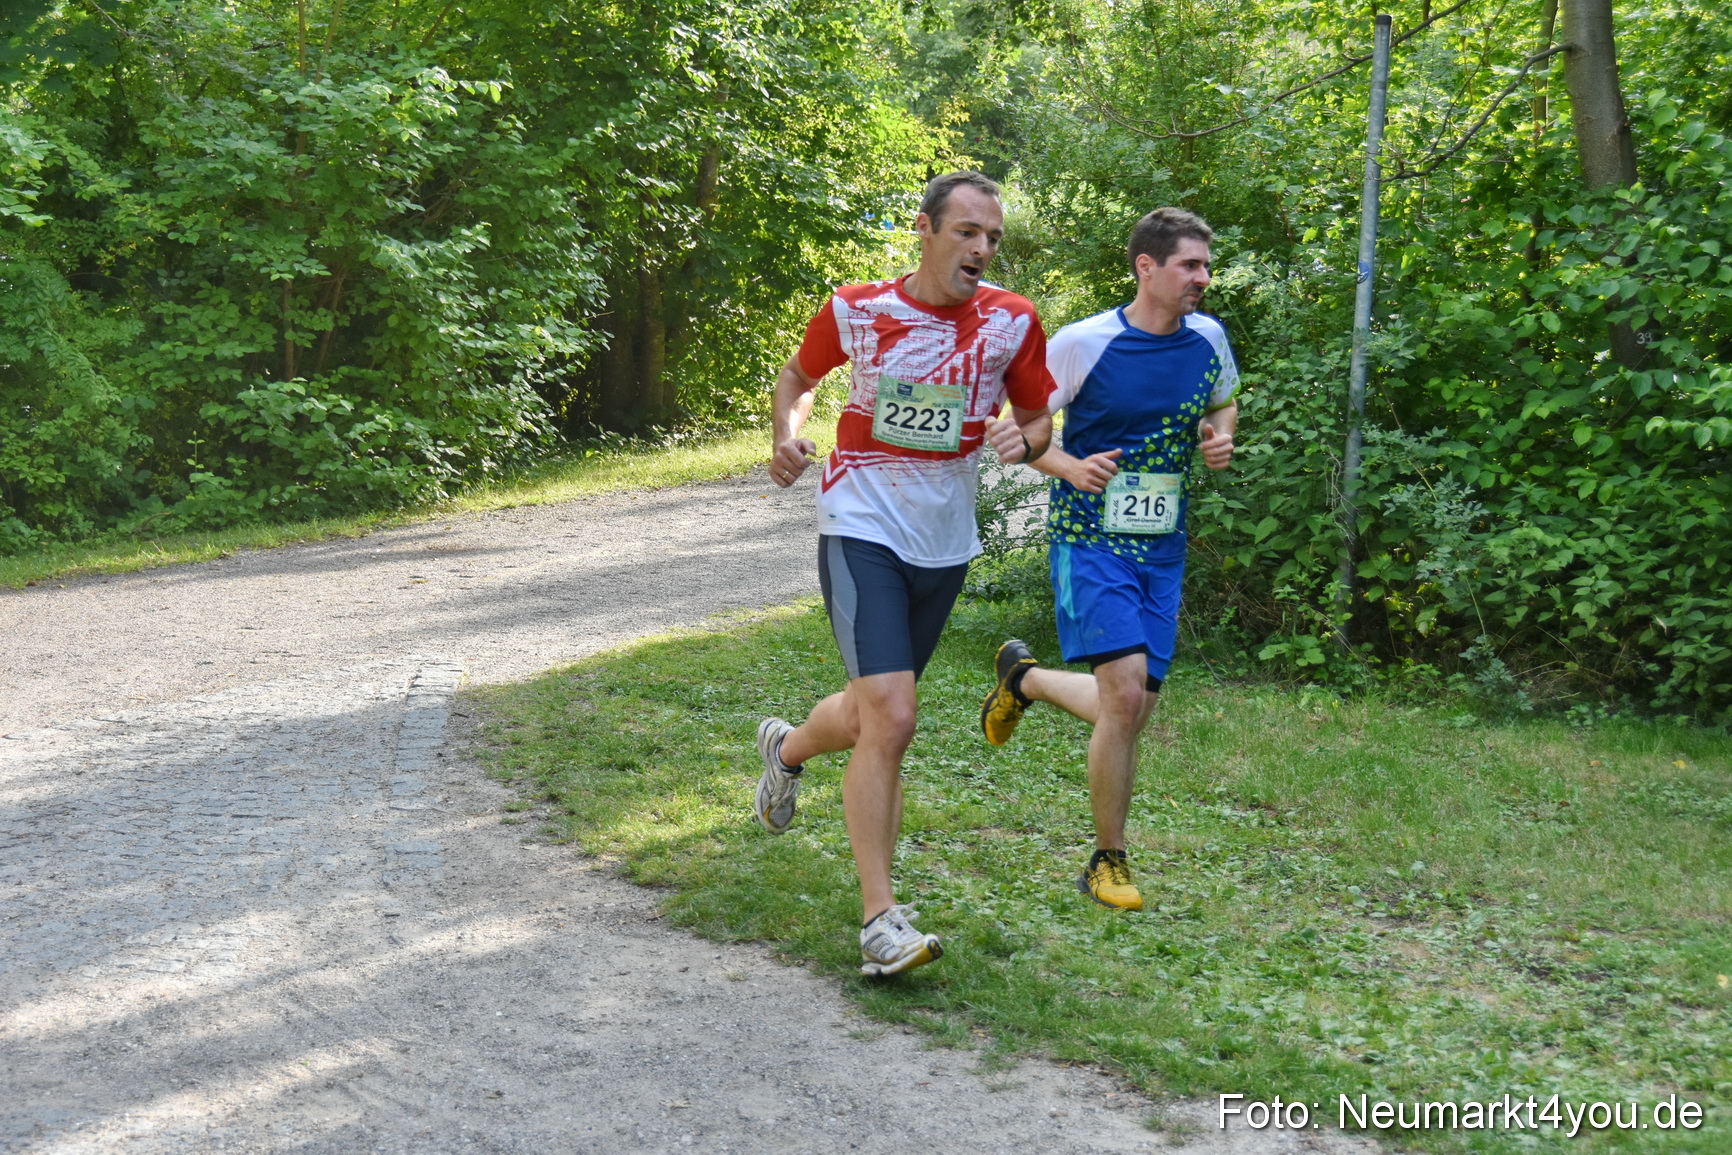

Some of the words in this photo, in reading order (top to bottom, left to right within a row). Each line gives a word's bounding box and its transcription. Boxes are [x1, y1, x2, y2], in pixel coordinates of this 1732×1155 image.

[883, 402, 951, 433] 2223
[911, 430, 944, 440] Bernhard
[1122, 494, 1167, 517] 216
